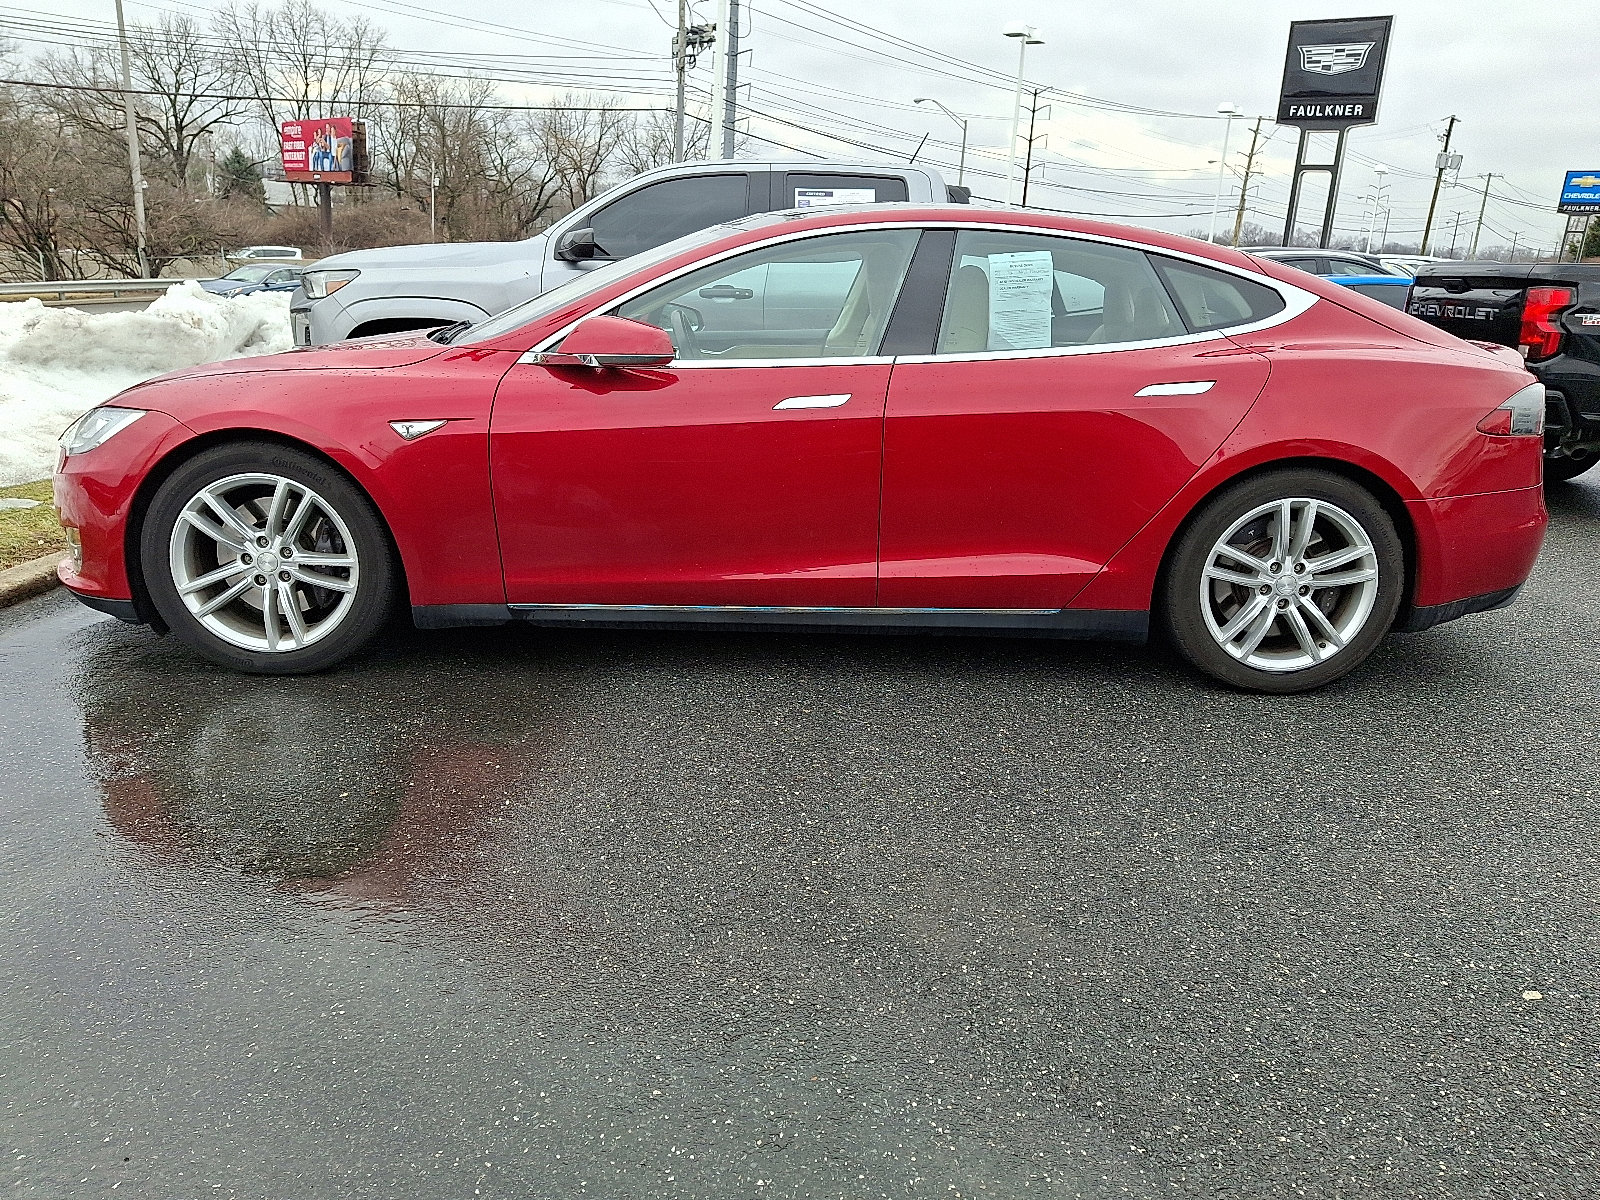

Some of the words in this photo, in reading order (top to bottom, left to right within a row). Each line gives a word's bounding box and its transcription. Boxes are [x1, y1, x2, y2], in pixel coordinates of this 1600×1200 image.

[1289, 104, 1364, 117] FAULKNER
[1563, 192, 1600, 200] CHEVROLE
[1411, 303, 1500, 321] CHEVROLET
